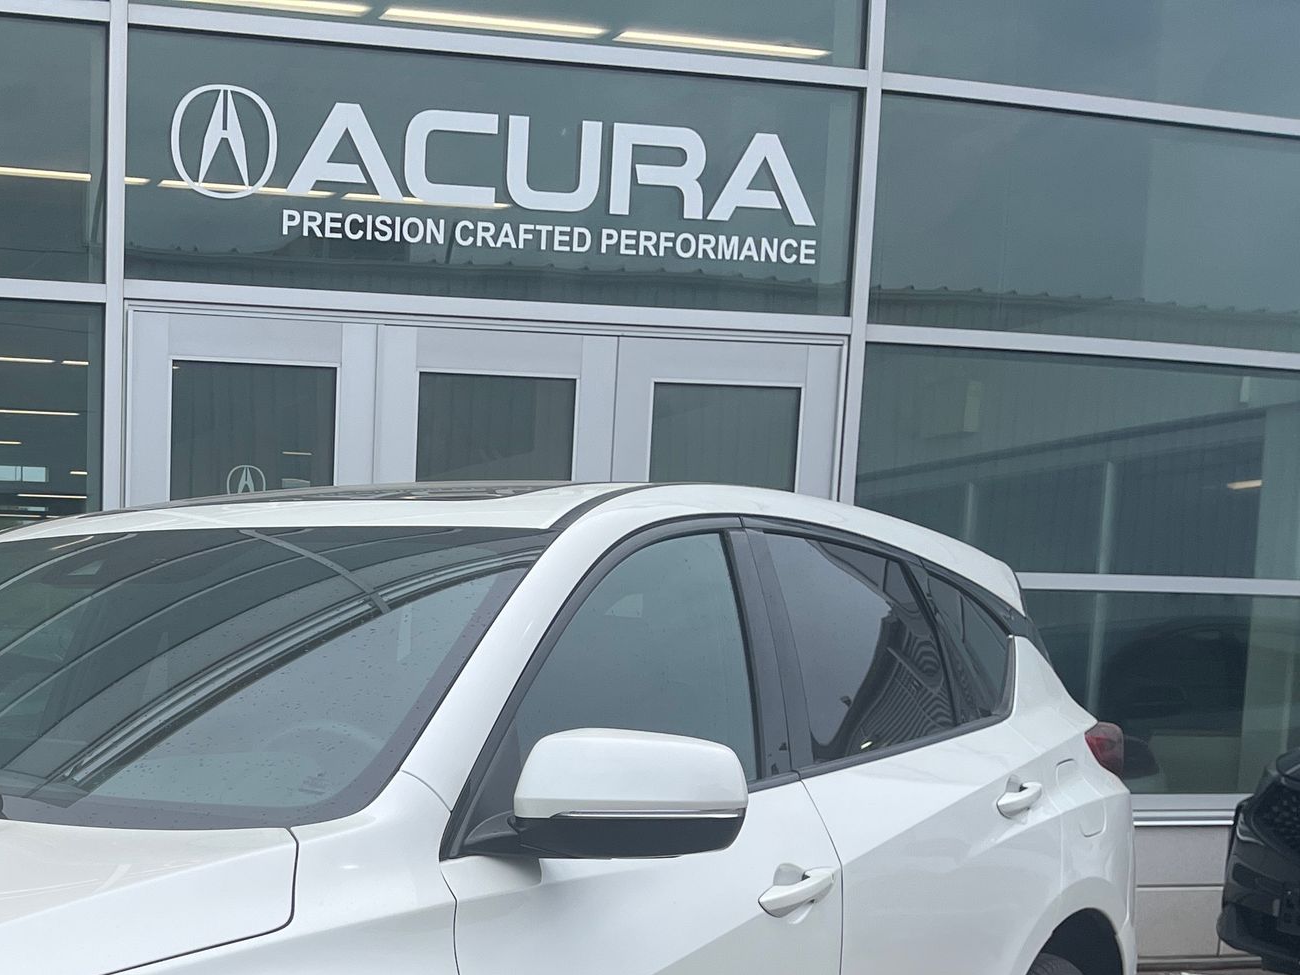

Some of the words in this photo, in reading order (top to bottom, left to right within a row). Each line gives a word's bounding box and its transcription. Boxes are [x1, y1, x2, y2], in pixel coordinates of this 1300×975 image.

[285, 101, 816, 227] ACURA
[282, 209, 445, 245] PRECISION
[455, 220, 592, 252] CRAFTED
[600, 228, 817, 265] PERFORMANCE
